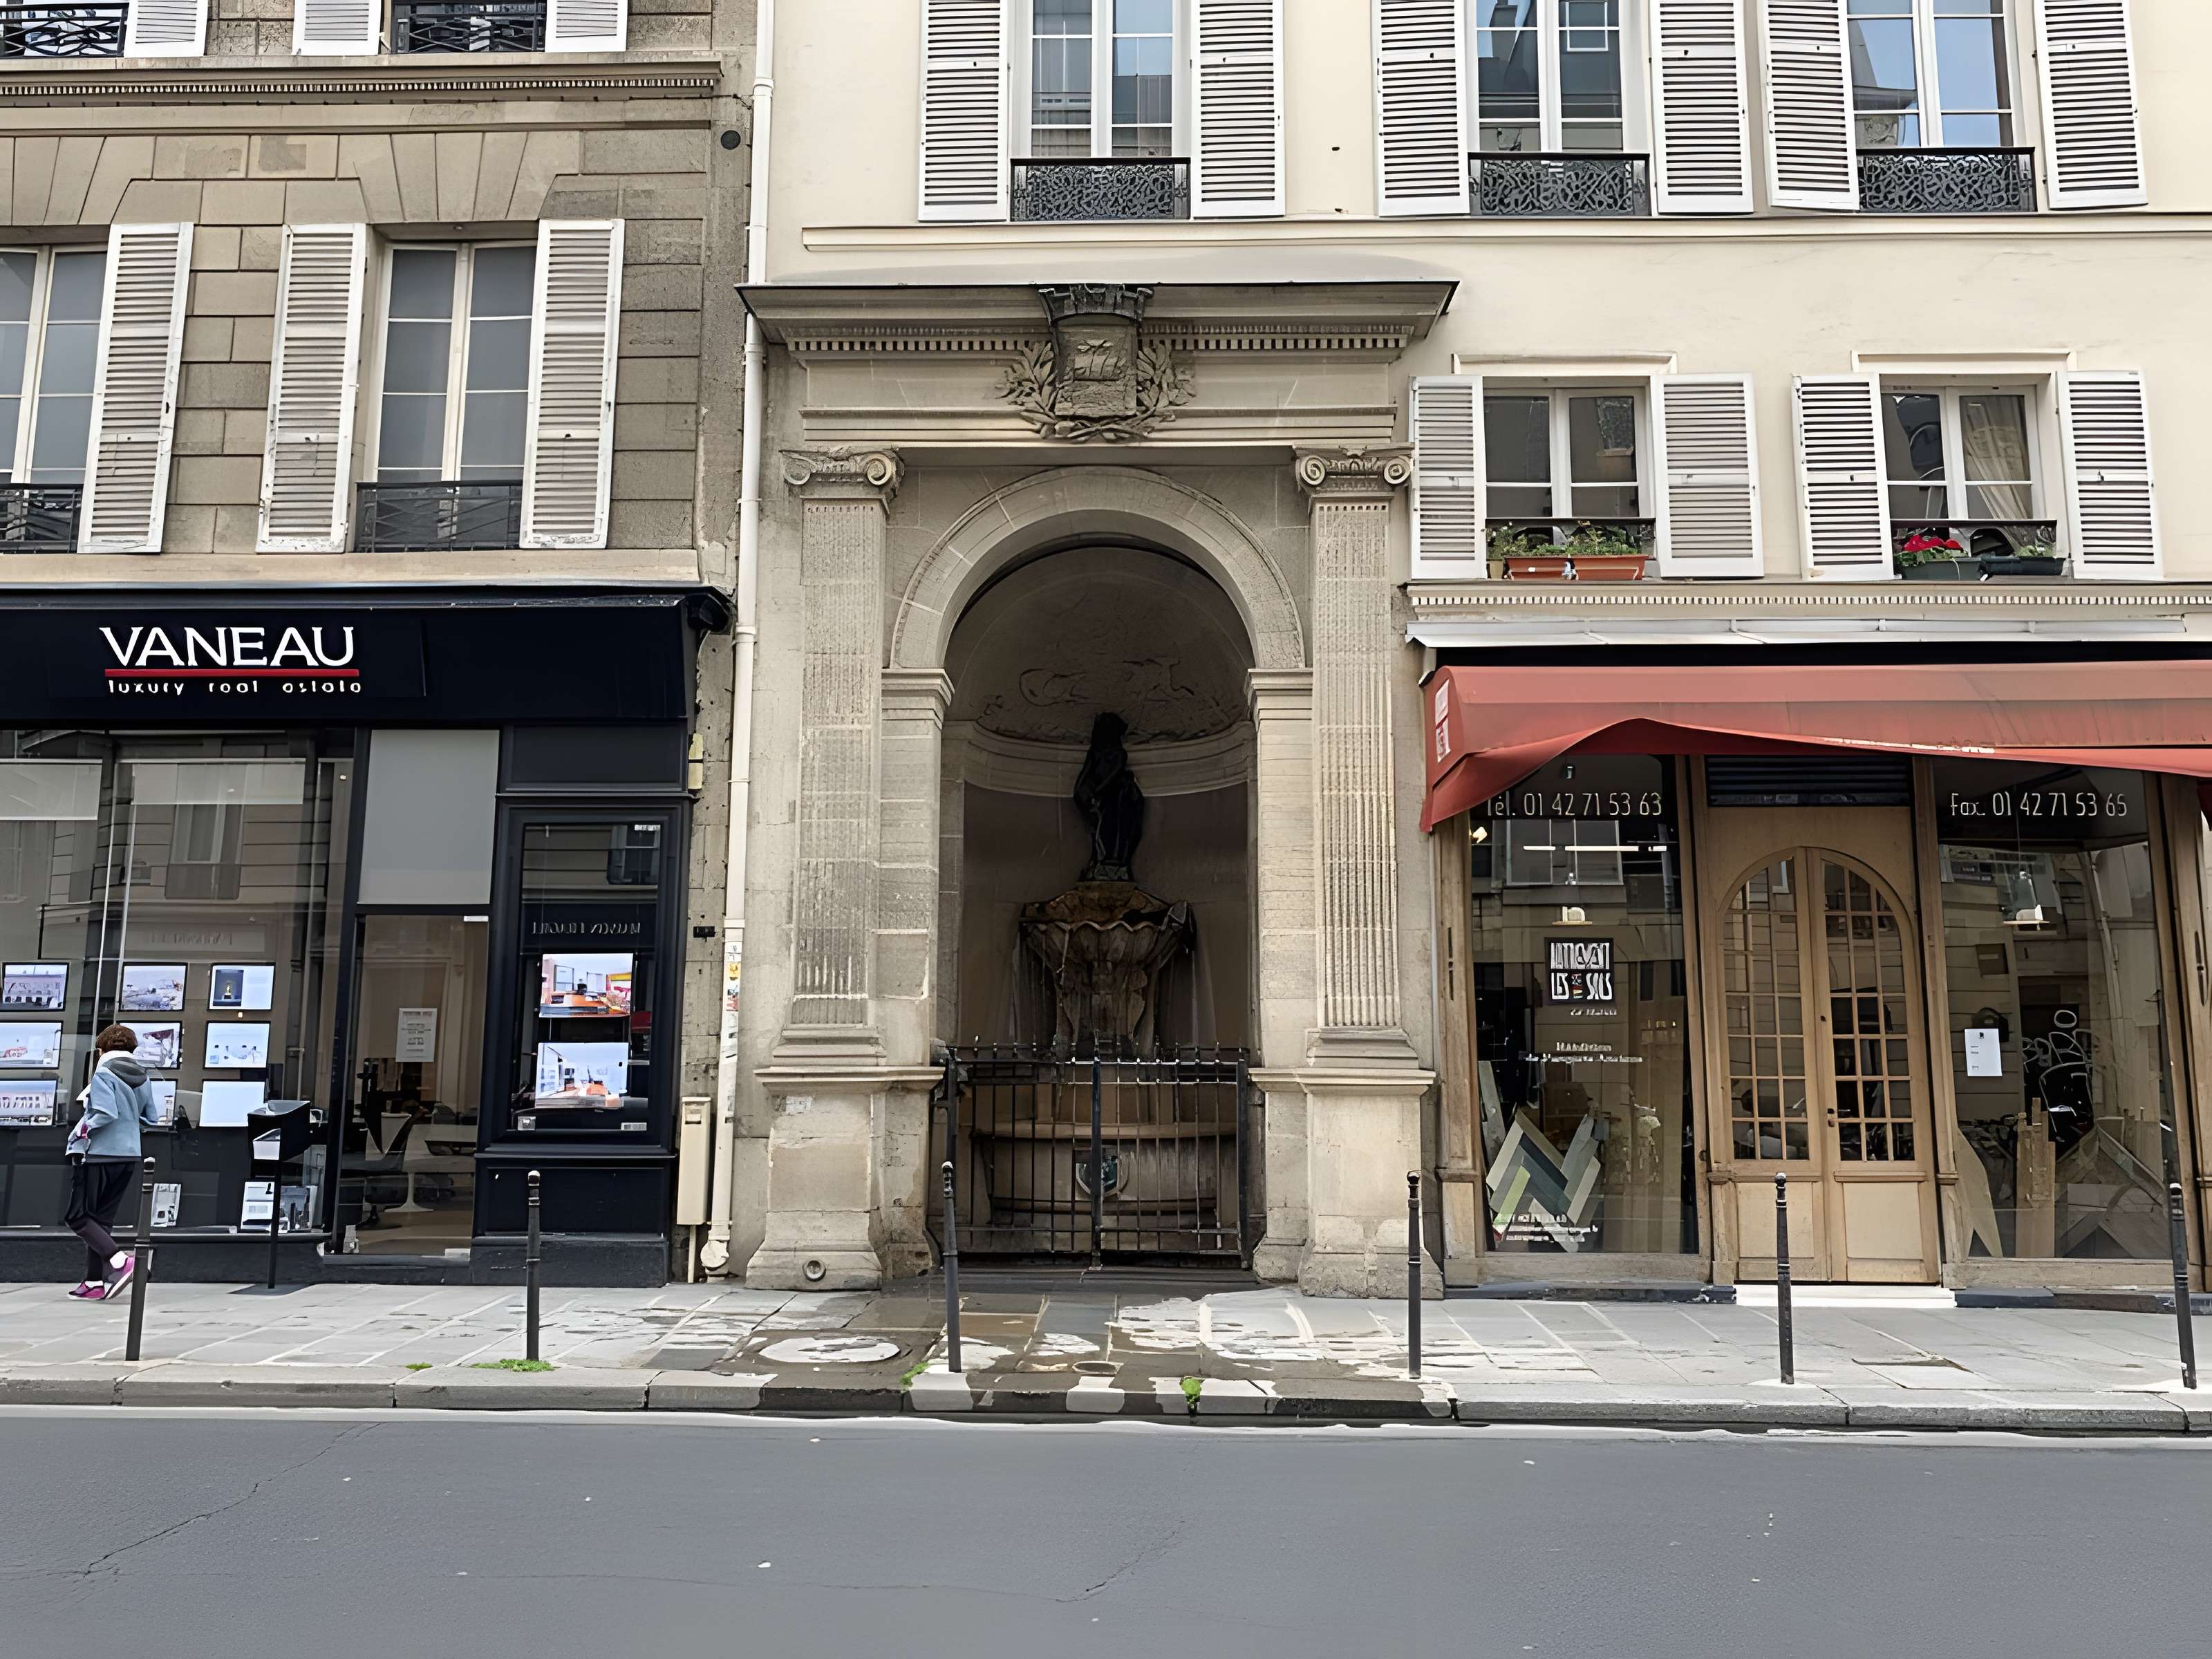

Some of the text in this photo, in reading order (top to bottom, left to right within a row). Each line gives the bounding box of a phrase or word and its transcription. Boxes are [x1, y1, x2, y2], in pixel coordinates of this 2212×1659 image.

[98, 626, 354, 666] VANEAU
[108, 679, 185, 695] luxury
[1524, 793, 1543, 816] 01
[1551, 793, 1575, 816] 42
[1582, 793, 1600, 816] 71
[1609, 792, 1631, 816] 53
[1640, 792, 1662, 816] 63
[1992, 791, 2012, 816] 01
[2020, 792, 2043, 816] 42
[2048, 793, 2068, 816] 71
[2076, 792, 2097, 816] 53
